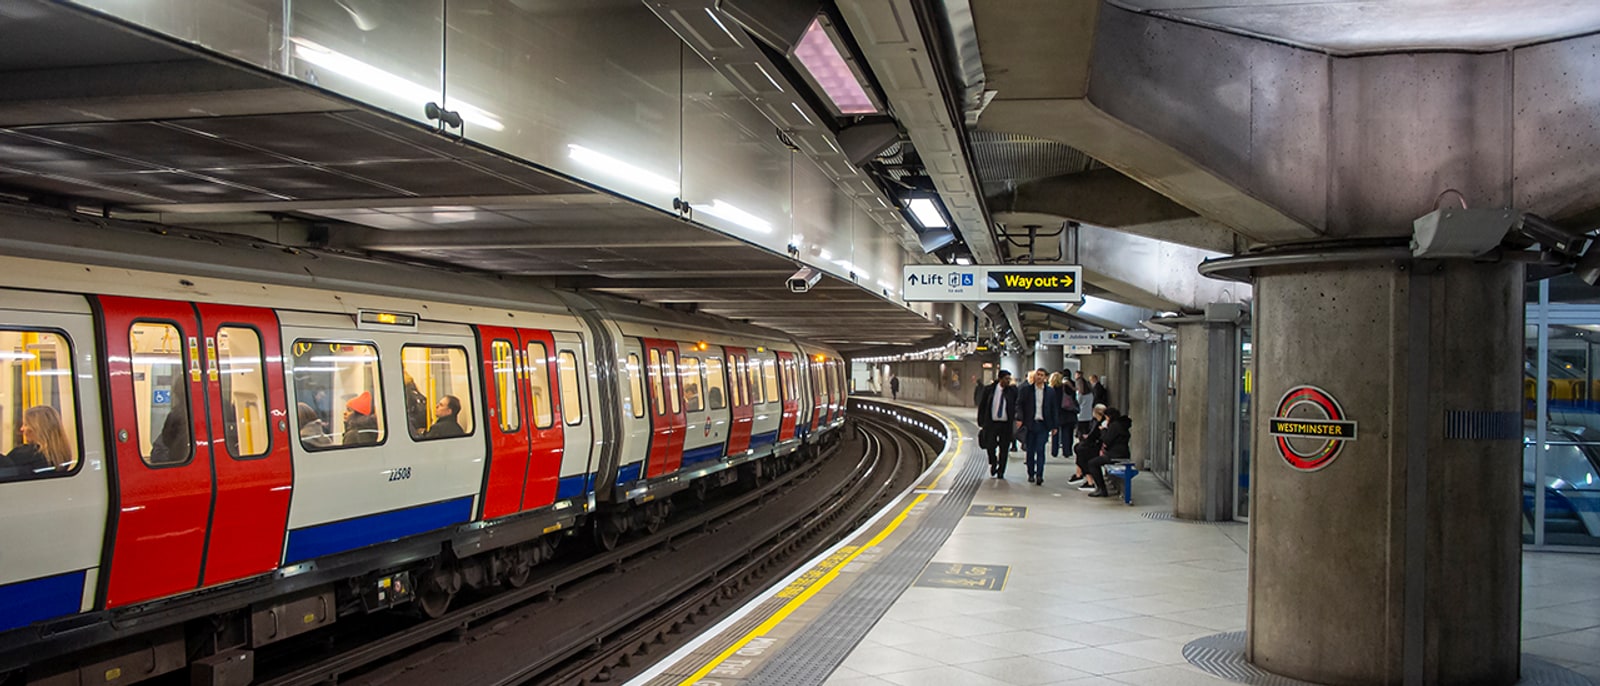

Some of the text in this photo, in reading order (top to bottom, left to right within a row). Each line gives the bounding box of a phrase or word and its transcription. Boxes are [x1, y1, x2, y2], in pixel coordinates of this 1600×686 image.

[921, 273, 943, 285] Lift
[1005, 274, 1058, 289] Way out
[1277, 423, 1343, 435] WESTMINSTER
[389, 467, 411, 482] 22508
[711, 658, 752, 676] THE
